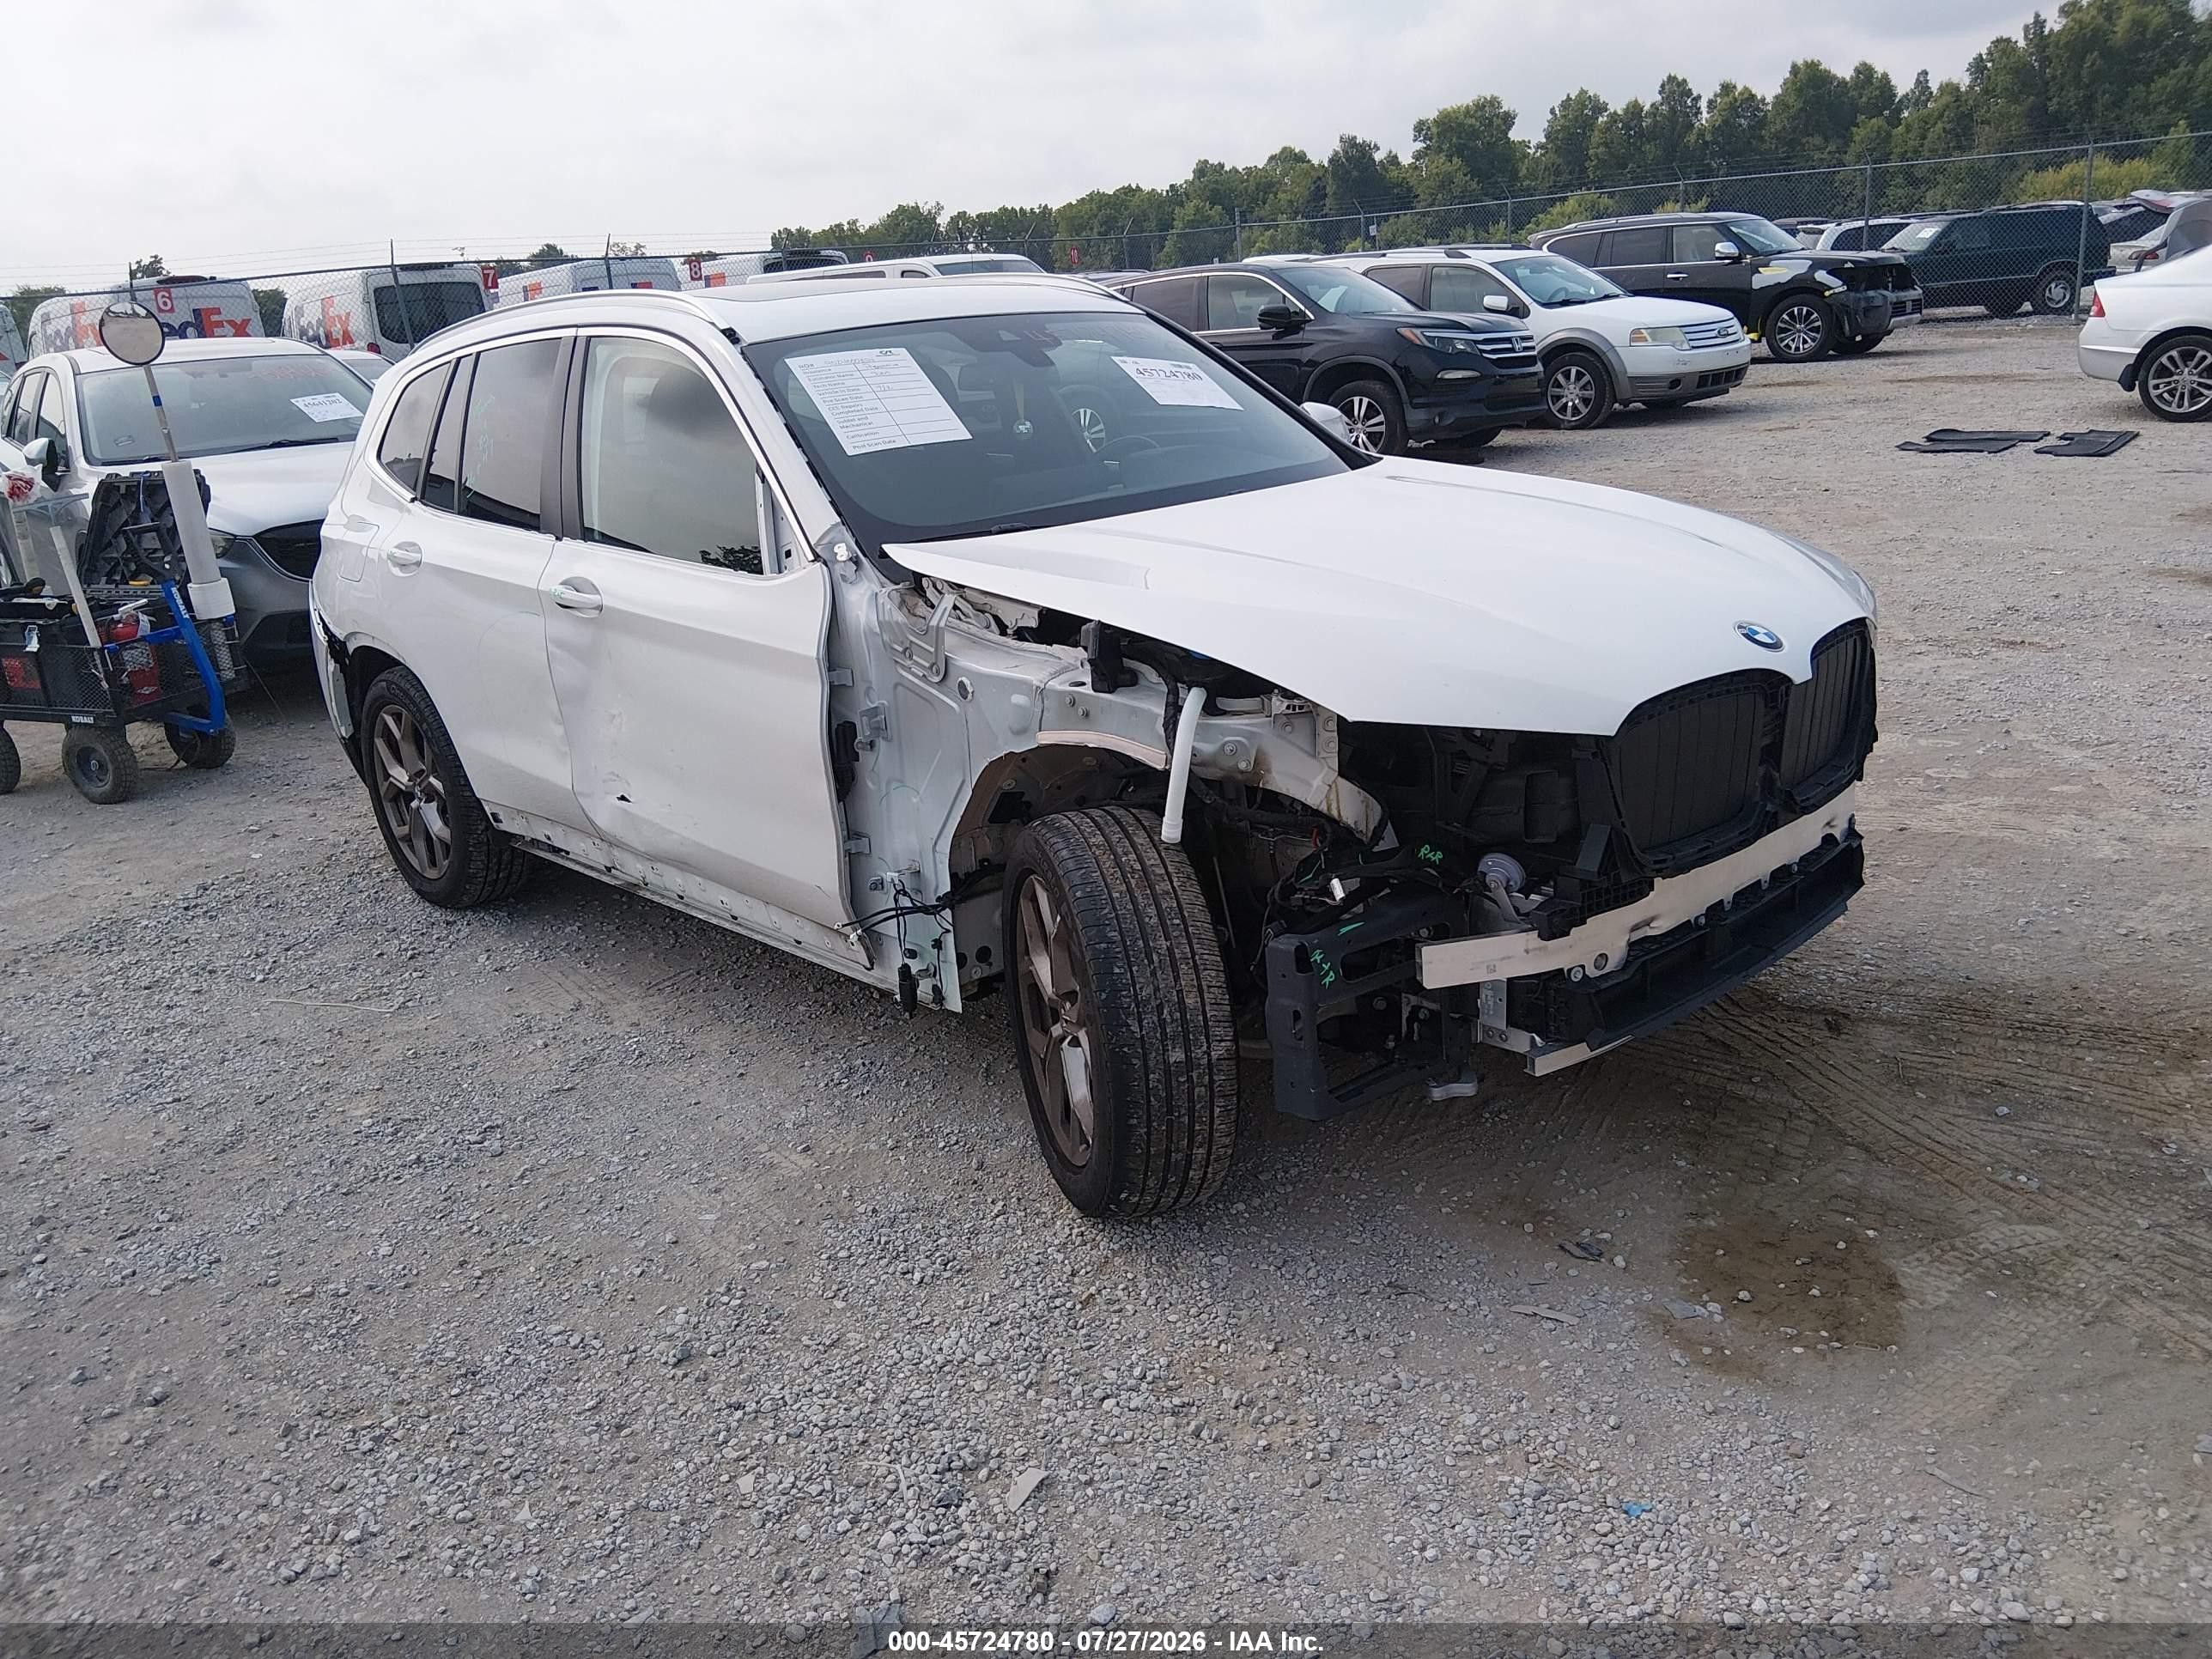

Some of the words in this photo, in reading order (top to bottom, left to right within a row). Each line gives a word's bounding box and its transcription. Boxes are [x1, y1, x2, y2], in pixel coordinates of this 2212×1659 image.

[690, 262, 701, 278] 8
[483, 270, 495, 287] 7
[157, 292, 172, 311] 6
[161, 307, 252, 338] edEx
[1135, 368, 1203, 381] 45724780
[831, 408, 864, 416] Completed
[840, 421, 873, 429] Mechanical
[846, 431, 879, 440] Calibration
